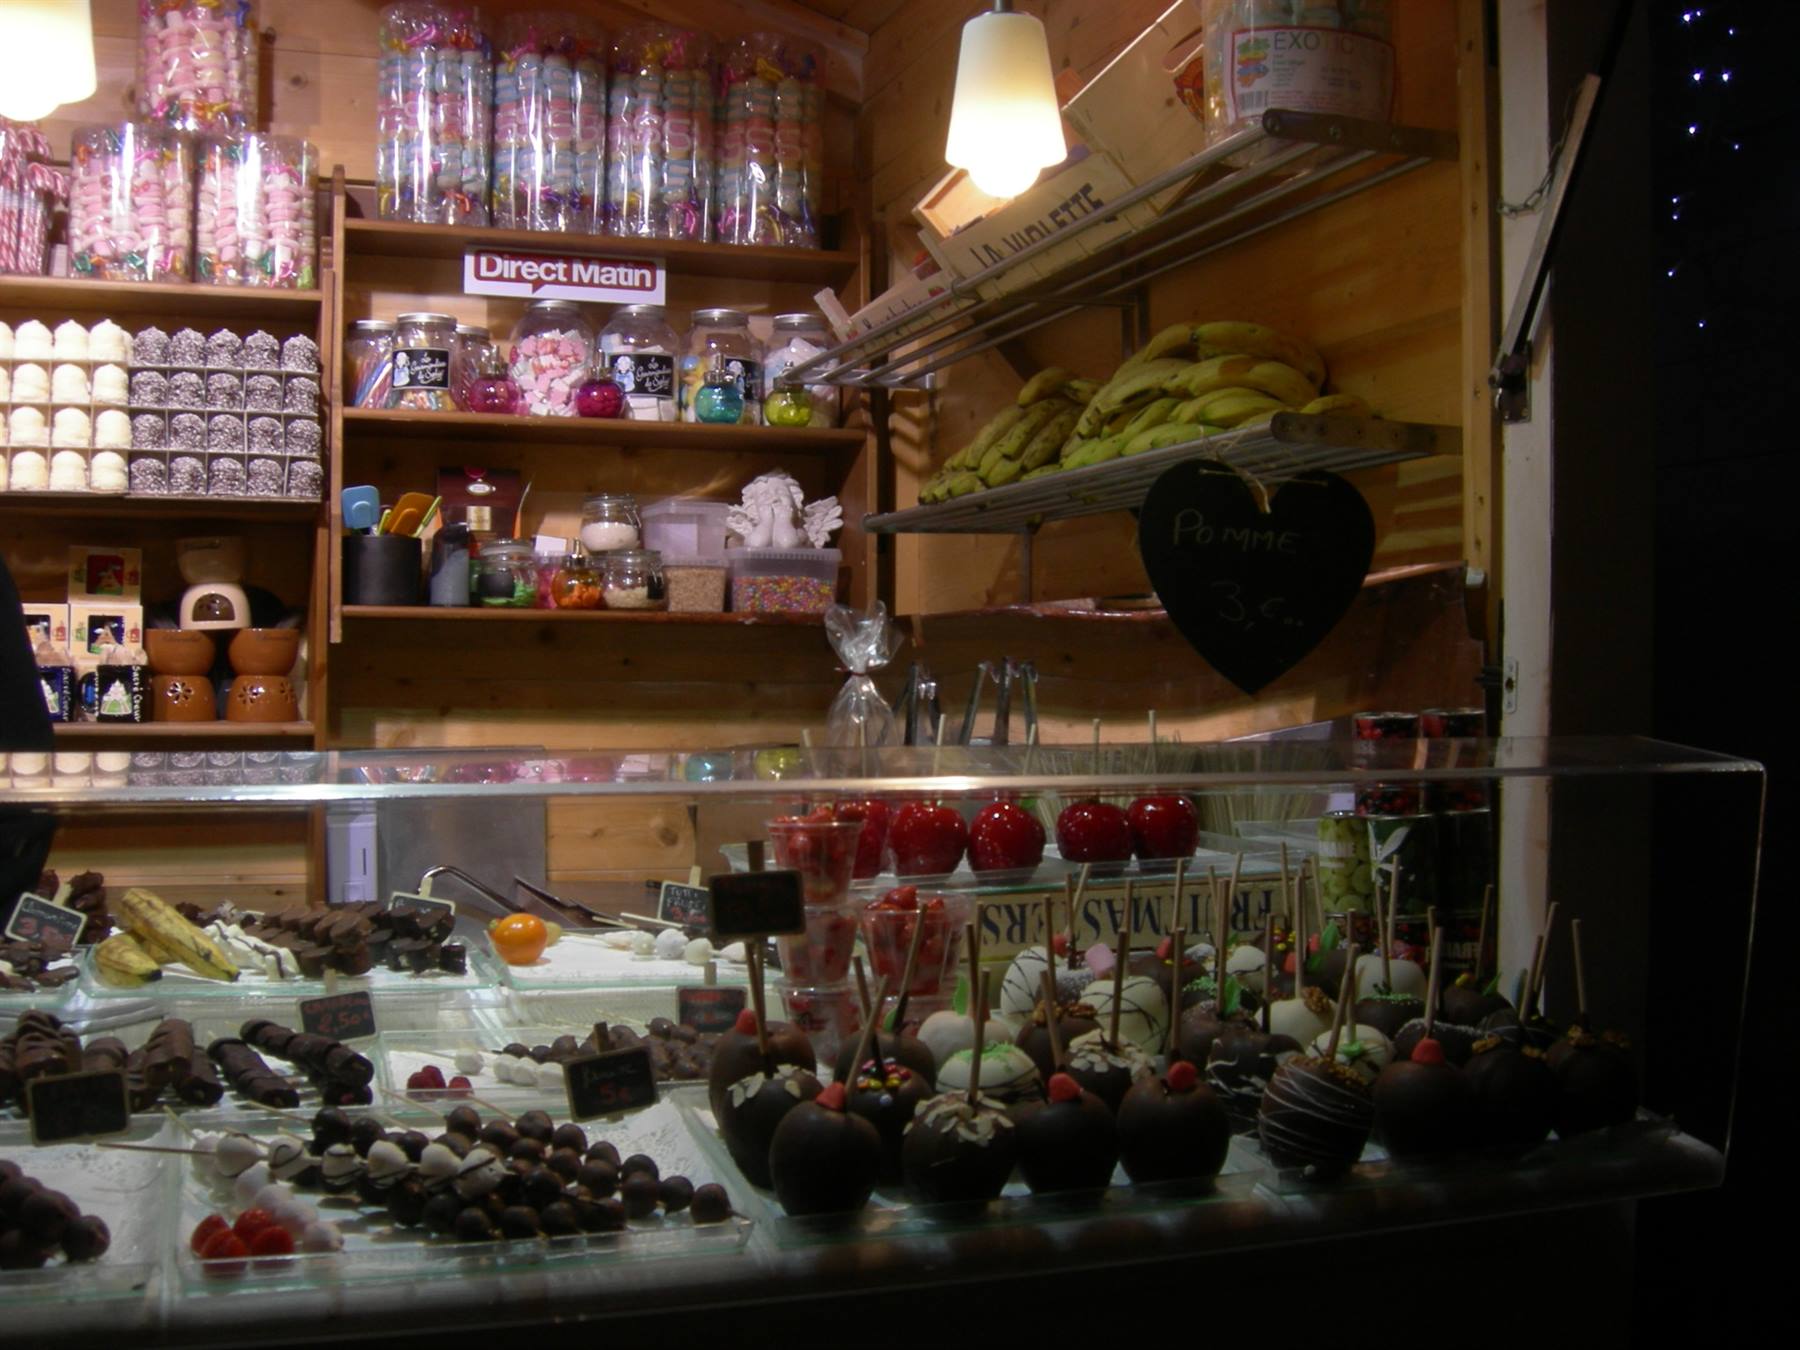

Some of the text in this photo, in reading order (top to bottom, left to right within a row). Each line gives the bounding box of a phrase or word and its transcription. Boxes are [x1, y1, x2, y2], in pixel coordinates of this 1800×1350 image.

[1003, 183, 1105, 252] VIOLETTE
[479, 253, 652, 288] Direct Matin
[1172, 507, 1302, 555] POMME
[980, 890, 1272, 945] FRIMASERS
